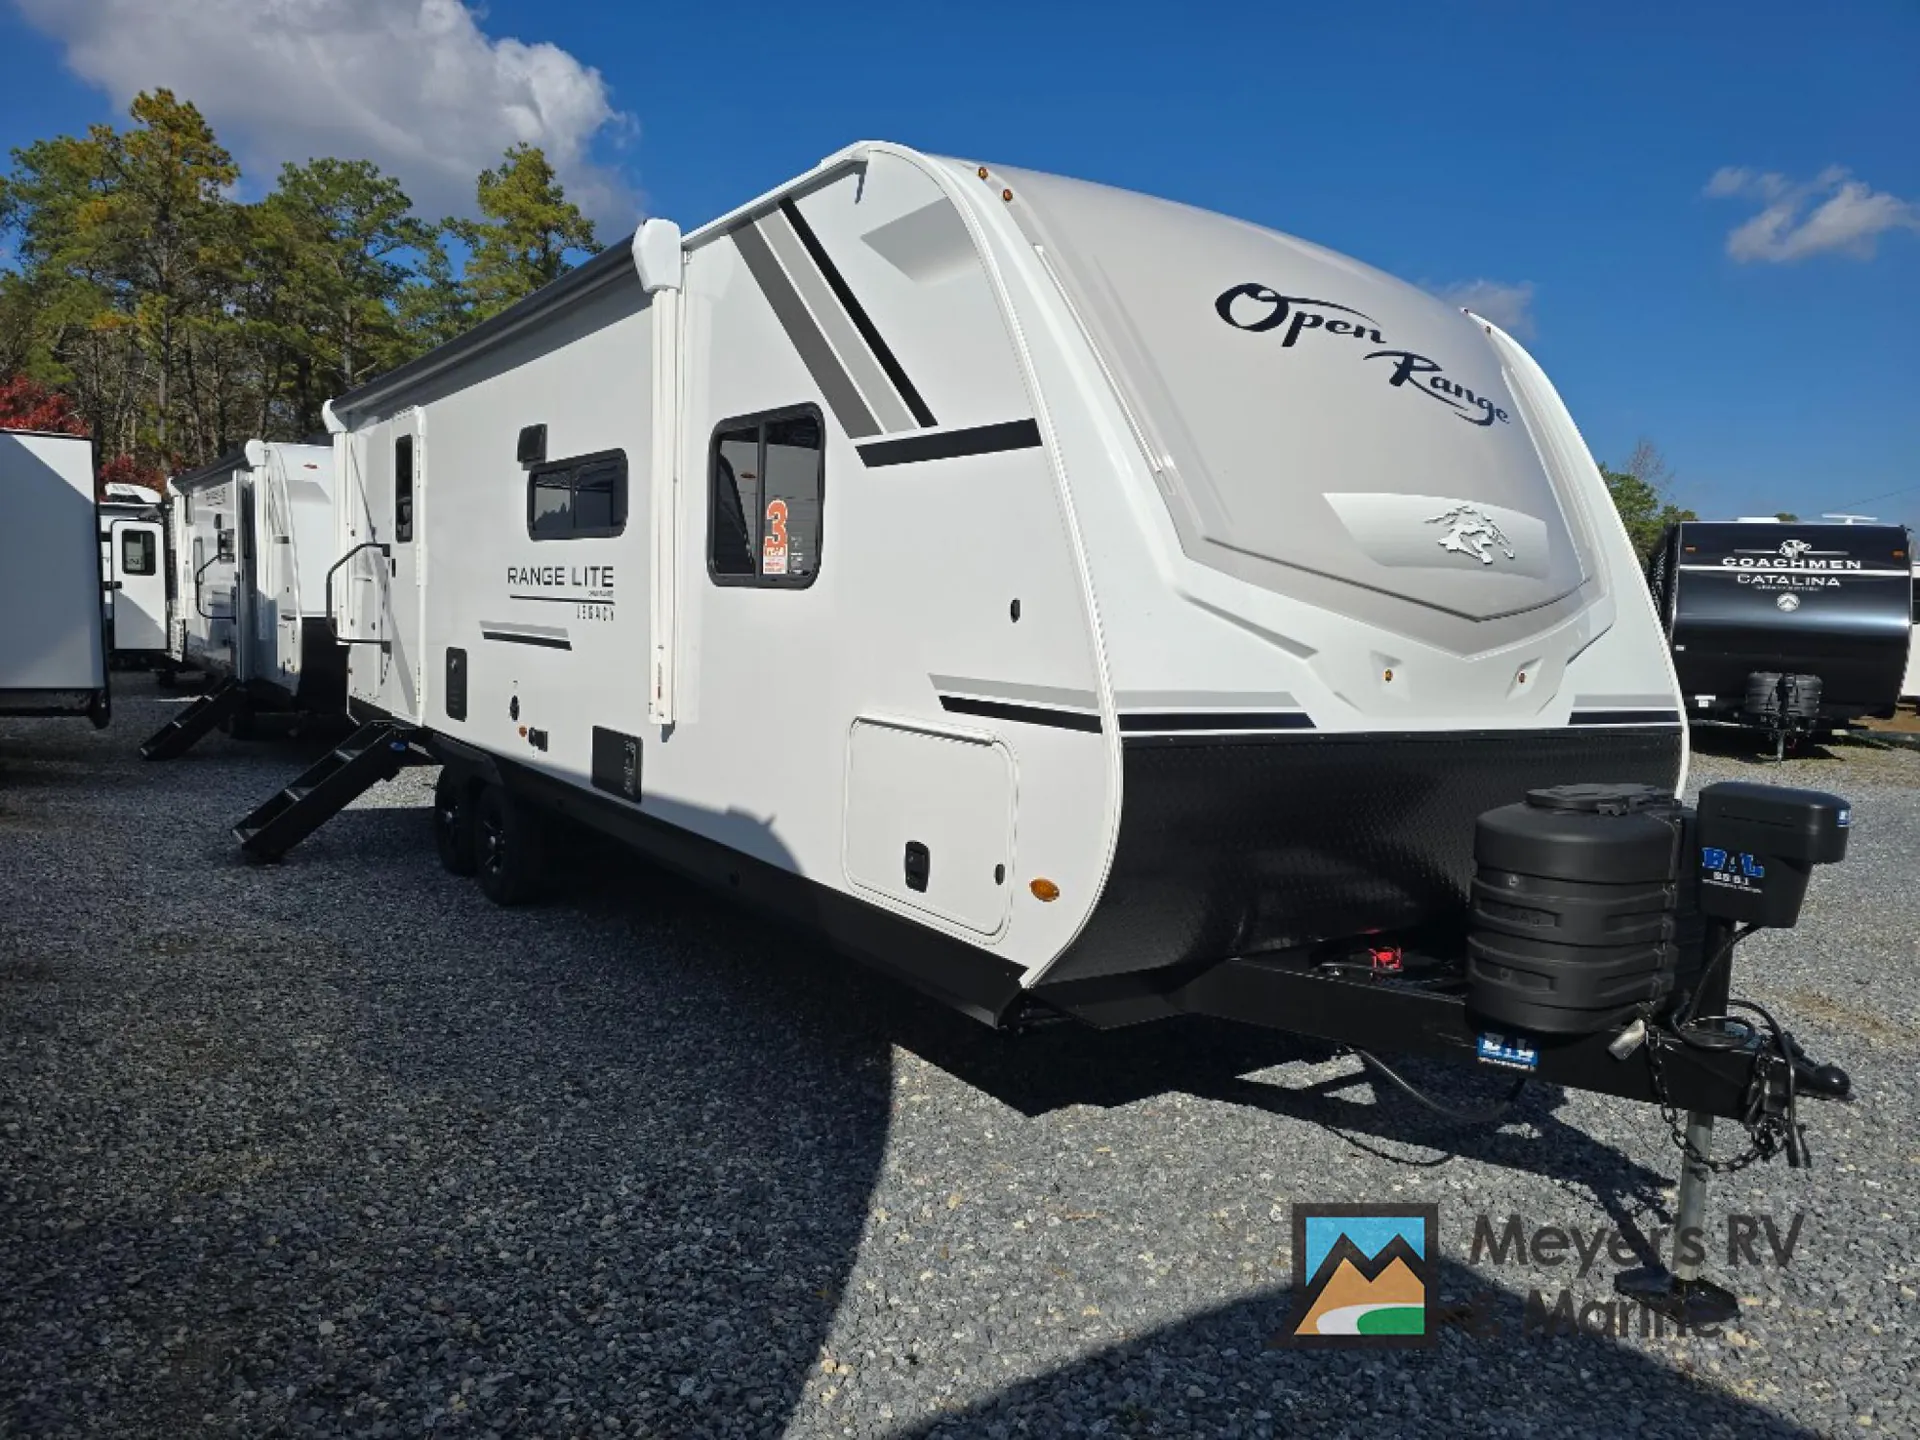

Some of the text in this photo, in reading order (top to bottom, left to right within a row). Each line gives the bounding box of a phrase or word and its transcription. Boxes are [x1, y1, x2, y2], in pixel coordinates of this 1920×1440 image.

[1215, 282, 1388, 348] Open
[1363, 350, 1510, 426] Range
[1722, 557, 1861, 569] COACHMEN
[507, 565, 614, 588] RANGE LITE
[1736, 573, 1841, 587] CATALINA
